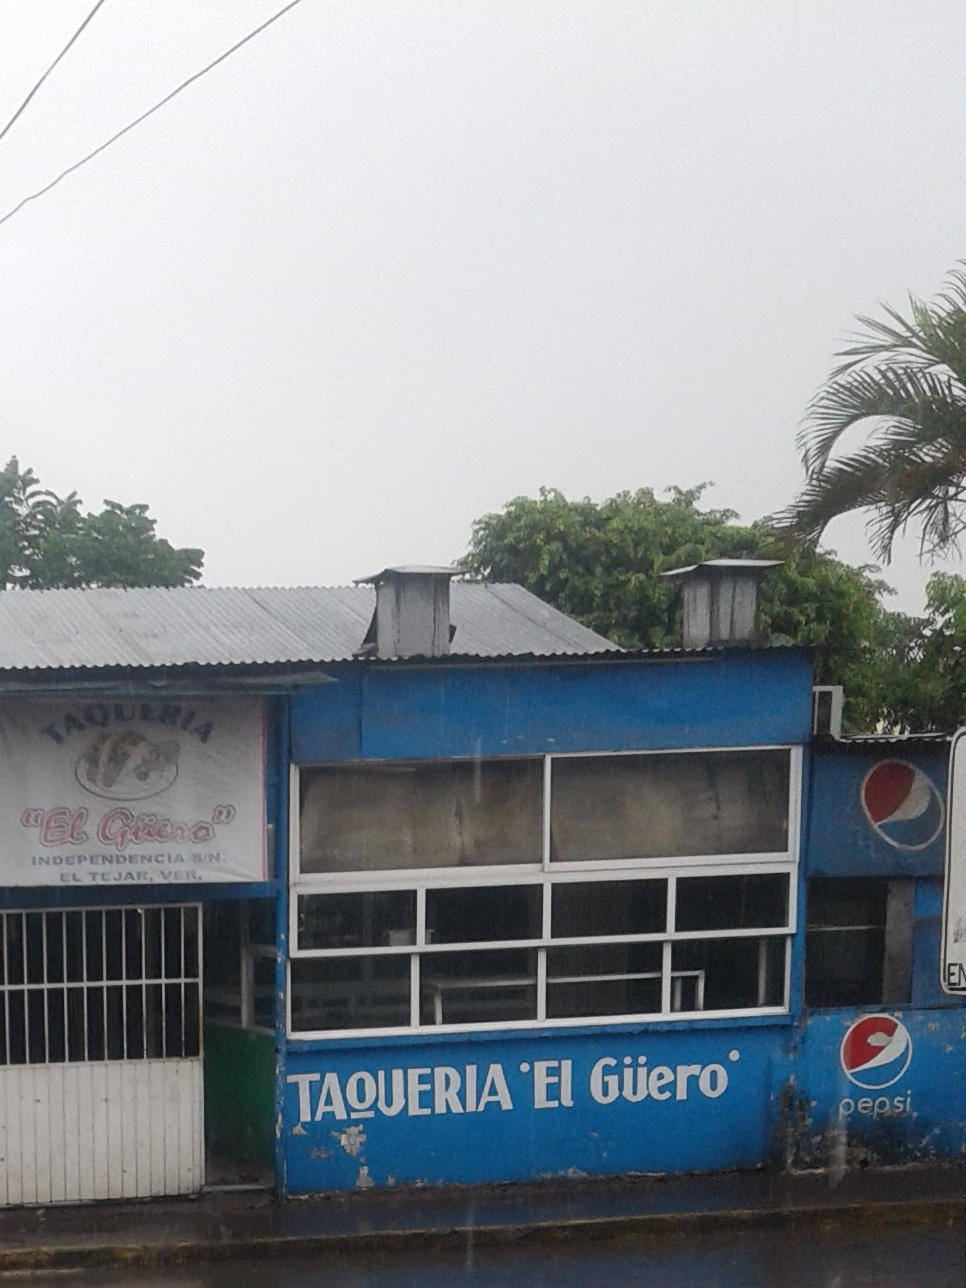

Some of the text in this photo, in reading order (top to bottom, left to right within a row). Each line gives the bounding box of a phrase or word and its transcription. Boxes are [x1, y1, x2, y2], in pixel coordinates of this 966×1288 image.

[41, 700, 215, 744] TAQUERIA
[31, 853, 185, 866] INDEPENDENCIA
[60, 872, 83, 882] EL
[88, 870, 155, 883] TEJAR,
[287, 1064, 513, 1122] TAQUERIA
[838, 1089, 911, 1120] pepsi
